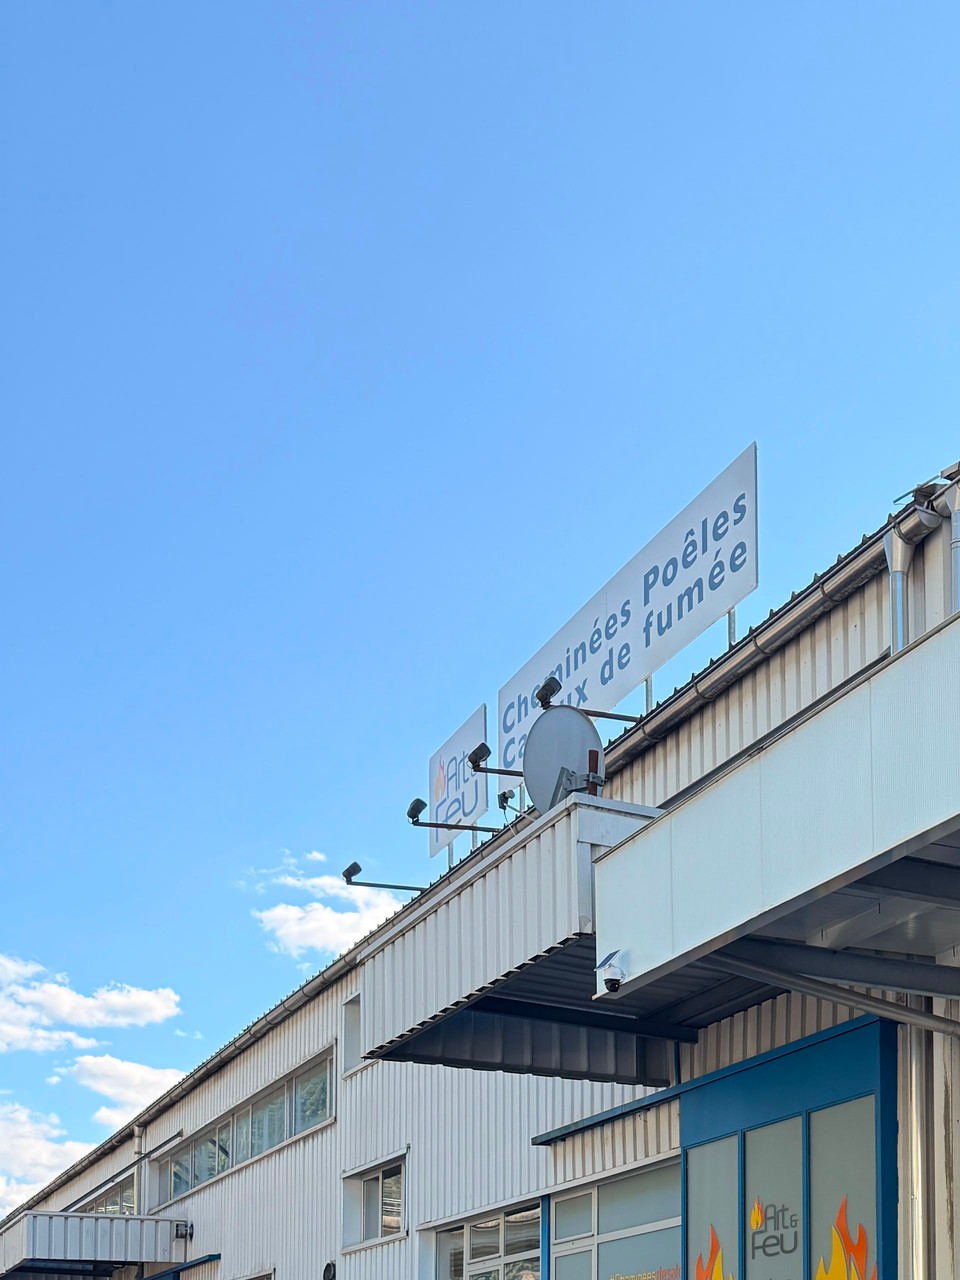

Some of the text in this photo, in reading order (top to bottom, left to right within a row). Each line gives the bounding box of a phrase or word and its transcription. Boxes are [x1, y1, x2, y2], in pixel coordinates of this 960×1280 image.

[643, 492, 747, 607] Poêles
[600, 642, 631, 686] de
[643, 541, 747, 648] fumée
[764, 1203, 799, 1231] Art &
